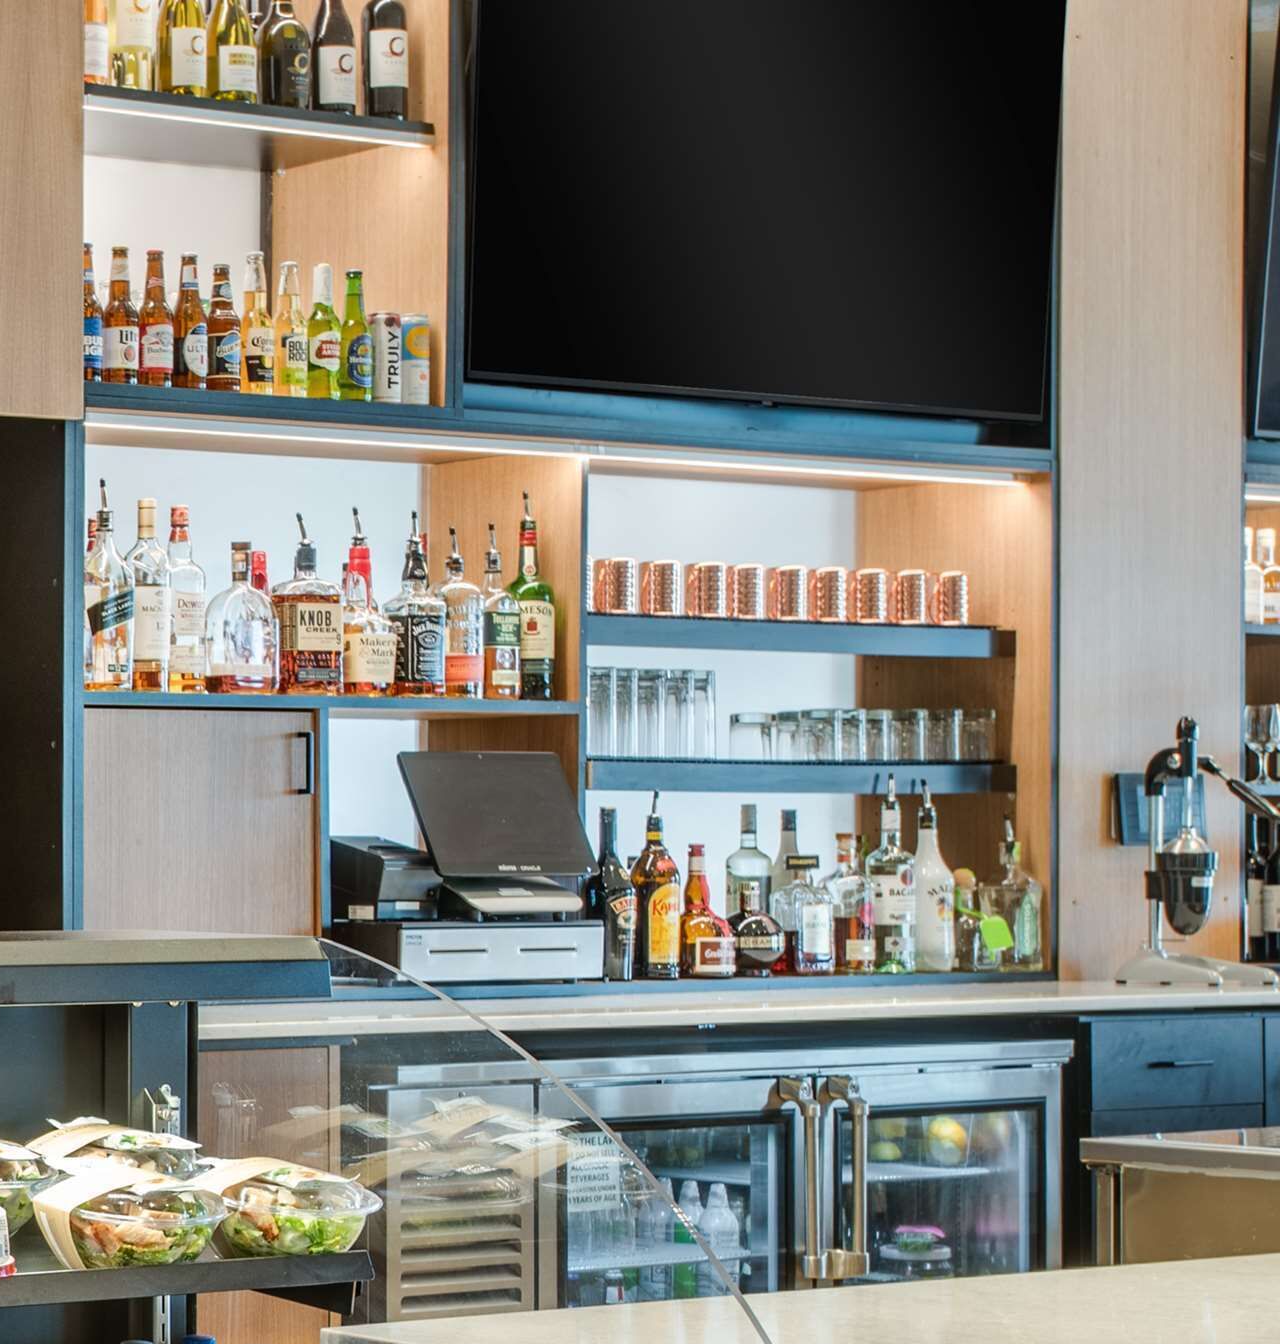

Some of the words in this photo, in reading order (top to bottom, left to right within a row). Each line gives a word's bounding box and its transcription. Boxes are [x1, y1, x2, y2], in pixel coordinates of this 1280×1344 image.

[288, 351, 307, 361] ROC
[388, 332, 399, 390] TRULY
[521, 605, 552, 616] MESON
[300, 610, 332, 627] KNOB
